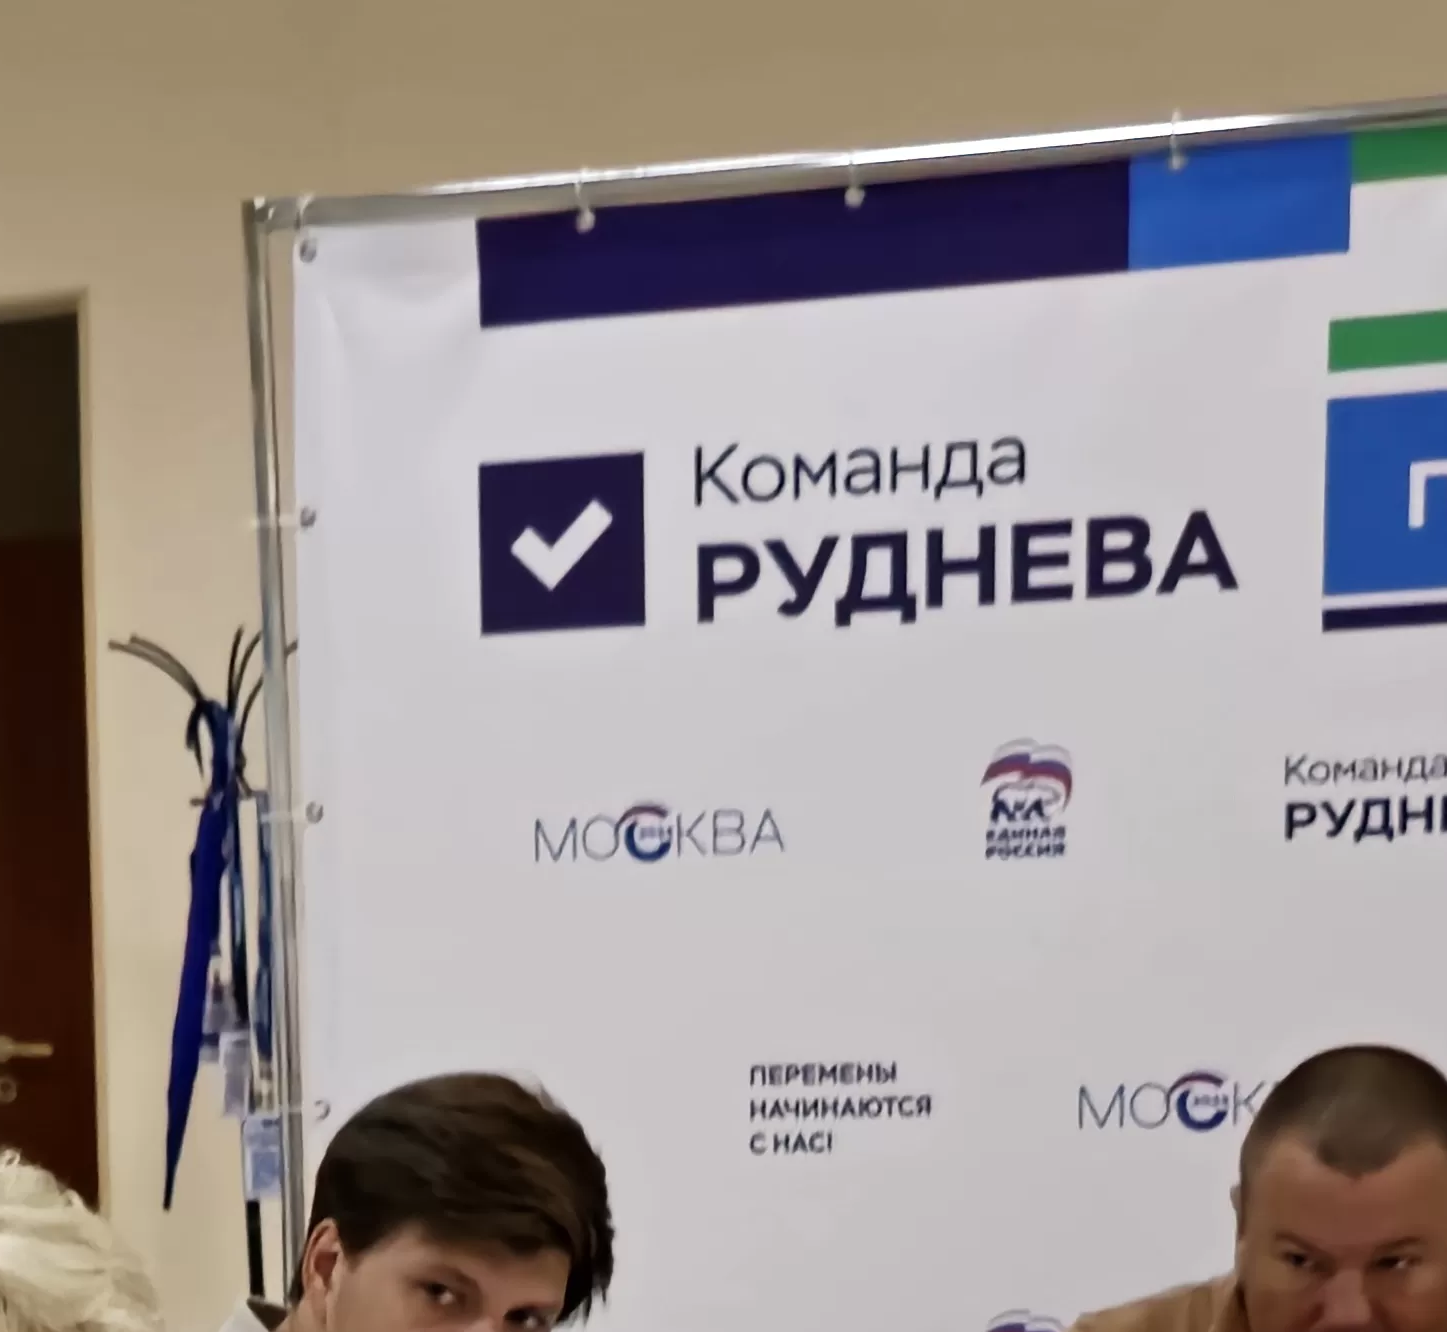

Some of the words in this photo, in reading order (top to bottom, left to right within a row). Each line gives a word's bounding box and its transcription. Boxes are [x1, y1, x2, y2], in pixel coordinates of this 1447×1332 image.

[693, 436, 1027, 507] Команда
[697, 510, 1239, 628] РУДНЕВА
[534, 801, 785, 864] МОСКВА
[749, 1061, 897, 1087] ПЕРЕМЕНЫ
[1077, 1069, 1280, 1131] МОСК
[749, 1095, 932, 1121] НАЧИНАЮТСЯ
[749, 1132, 767, 1154] С
[772, 1132, 833, 1154] НАС!
